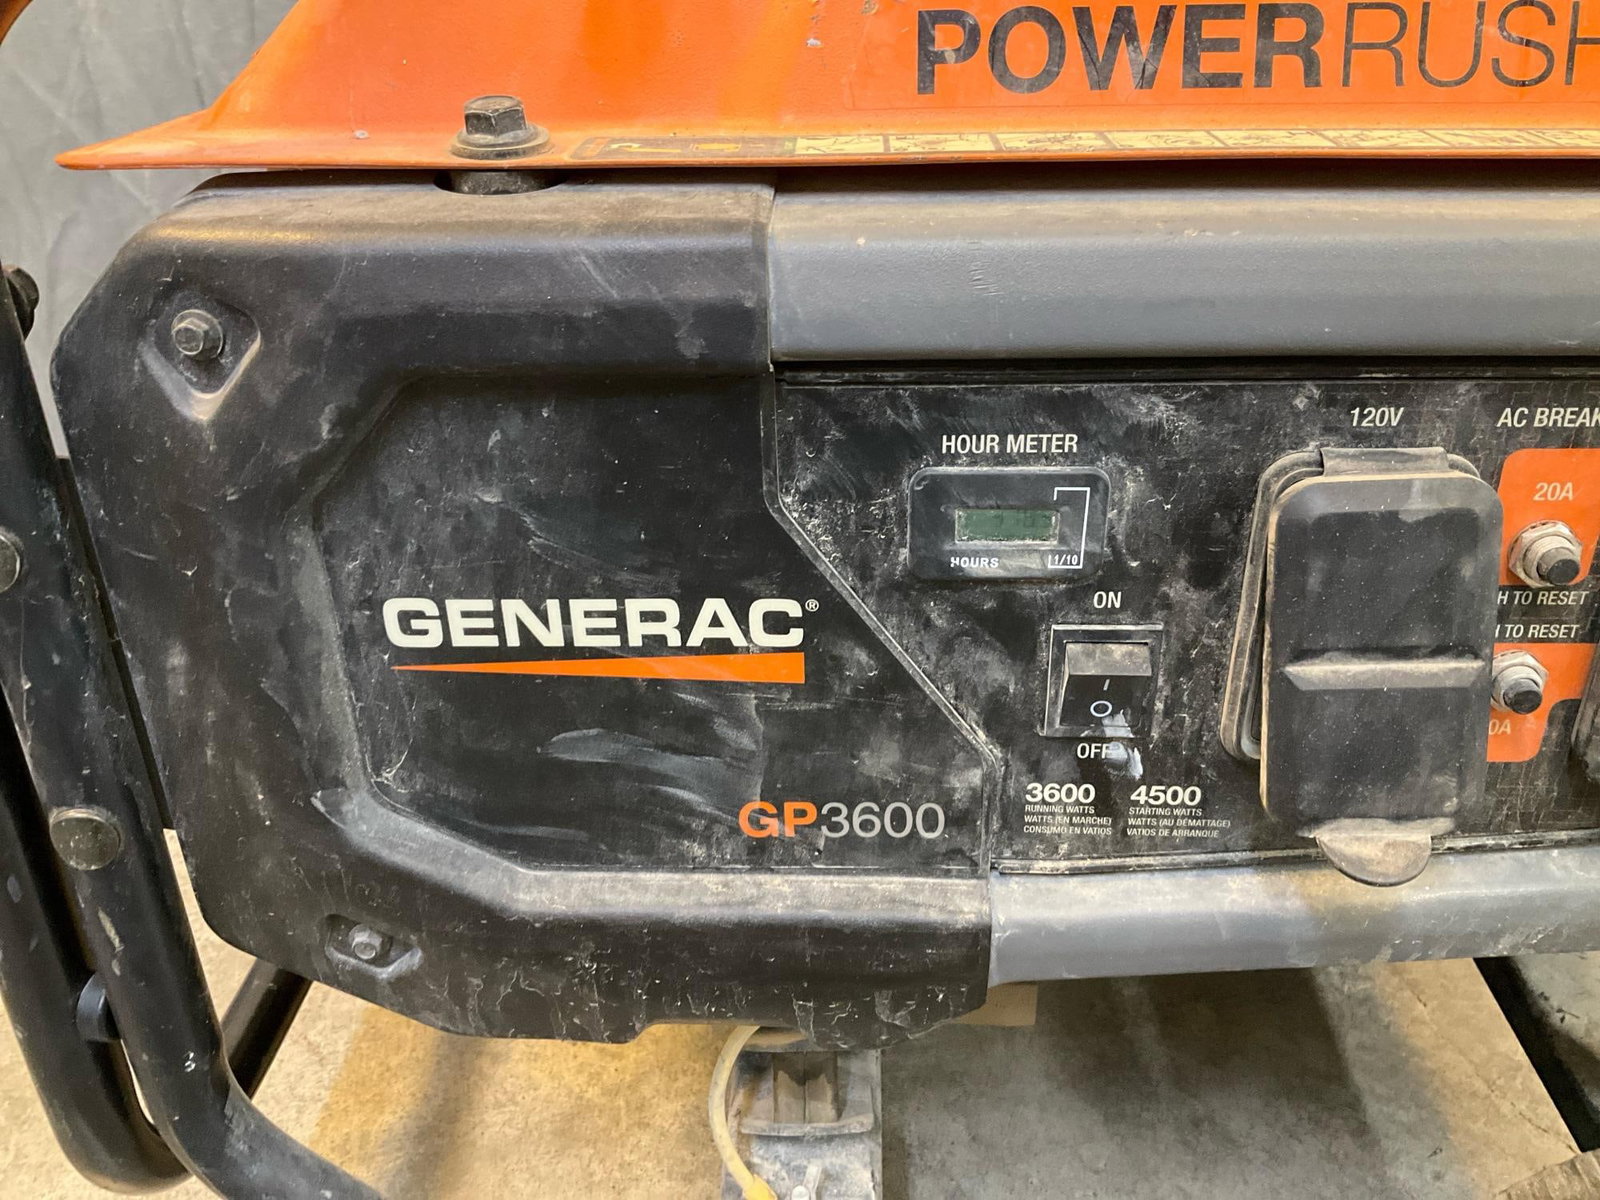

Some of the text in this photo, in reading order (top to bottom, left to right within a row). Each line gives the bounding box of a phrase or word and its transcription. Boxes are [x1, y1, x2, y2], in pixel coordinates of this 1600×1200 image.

[1350, 407, 1404, 427] 120V
[1496, 407, 1529, 427] AC
[941, 433, 1079, 454] HOUR METER
[1532, 481, 1574, 501] 20A
[950, 556, 1000, 568] HOURS
[1053, 554, 1078, 565] 1/10
[1093, 591, 1122, 609] ON
[1513, 591, 1533, 605] TO
[1536, 590, 1590, 605] RESET
[1504, 624, 1524, 638] TO
[1527, 624, 1580, 638] RESET
[1076, 743, 1112, 759] OFF
[1025, 782, 1096, 803] 3600
[1130, 785, 1202, 806] 4500
[1024, 804, 1095, 814] RUNNING WATTS
[1128, 806, 1203, 816] STARTING WATTS
[738, 801, 945, 839] GP3600
[1024, 815, 1053, 823] WATTS
[1127, 817, 1157, 826] WATTS
[1159, 818, 1174, 827] (AU
[1023, 825, 1112, 835] CONSUMO EN VATIOS
[1126, 828, 1220, 838] VATIOS DE ARRANQUE
